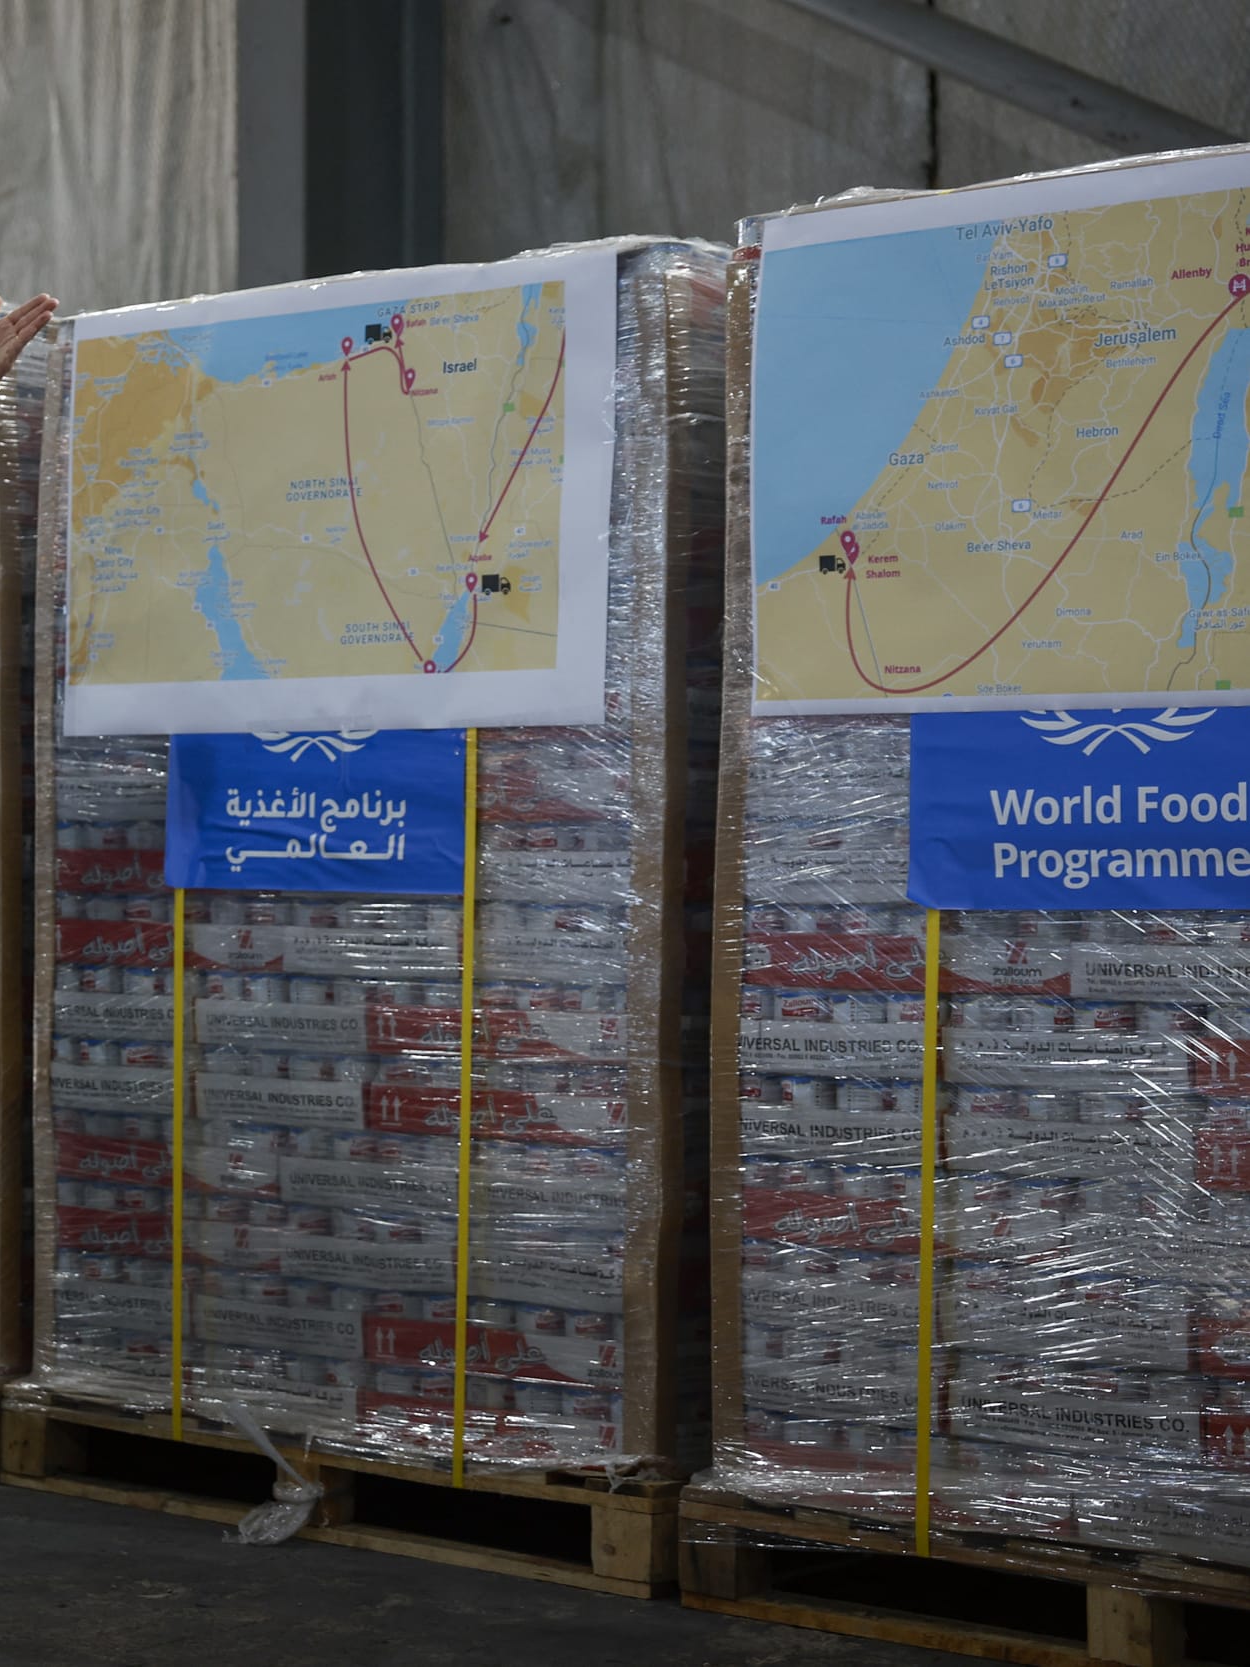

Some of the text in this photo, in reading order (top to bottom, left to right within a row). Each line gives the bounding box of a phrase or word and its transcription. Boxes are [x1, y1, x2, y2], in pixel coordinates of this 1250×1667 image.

[956, 216, 1053, 241] Tel Aviv-Yafo
[990, 263, 1028, 276] Rishon
[1171, 268, 1212, 280] Allenby
[984, 276, 1034, 291] LeTsiyon
[1110, 277, 1154, 290] Ramallah
[377, 301, 441, 318] GAZA STRIP
[943, 334, 985, 347] Ashdod
[1094, 327, 1177, 348] Jerusalem
[442, 358, 478, 375] Israel
[1106, 355, 1157, 369] Bethlehem
[1076, 425, 1119, 439] Hebron
[888, 453, 925, 466] Gaza
[290, 479, 326, 490] NORTH
[286, 487, 363, 502] GOVERNORAE
[820, 514, 847, 525] Rafah
[1120, 530, 1143, 540] Arad
[997, 539, 1031, 551] Sheva
[467, 554, 492, 563] Aqaba
[868, 555, 898, 564] Kerem
[1155, 552, 1171, 562] Ein
[866, 569, 901, 579] Shalom
[1055, 607, 1091, 617] Dimona
[345, 622, 379, 633] SOUTH
[340, 631, 415, 646] GOVERNORAE
[1022, 640, 1062, 649] Yeruham
[884, 664, 921, 674] Nitzana
[225, 786, 407, 832] برنامج الأغذية
[990, 781, 1248, 826] World Food
[225, 833, 406, 873] العالمي
[993, 842, 1250, 889] Programme
[992, 966, 1042, 977] zalloum
[1085, 962, 1178, 978] UNIVERSAL
[270, 1017, 337, 1031] INDUSTRIES
[804, 1039, 896, 1053] INDUSTRIES
[268, 1091, 333, 1108] INDUSTRIES
[810, 1124, 897, 1142] INDUSTRIES
[1055, 1407, 1154, 1431] INDUSTRIES
[1159, 1417, 1190, 1434] CO.
